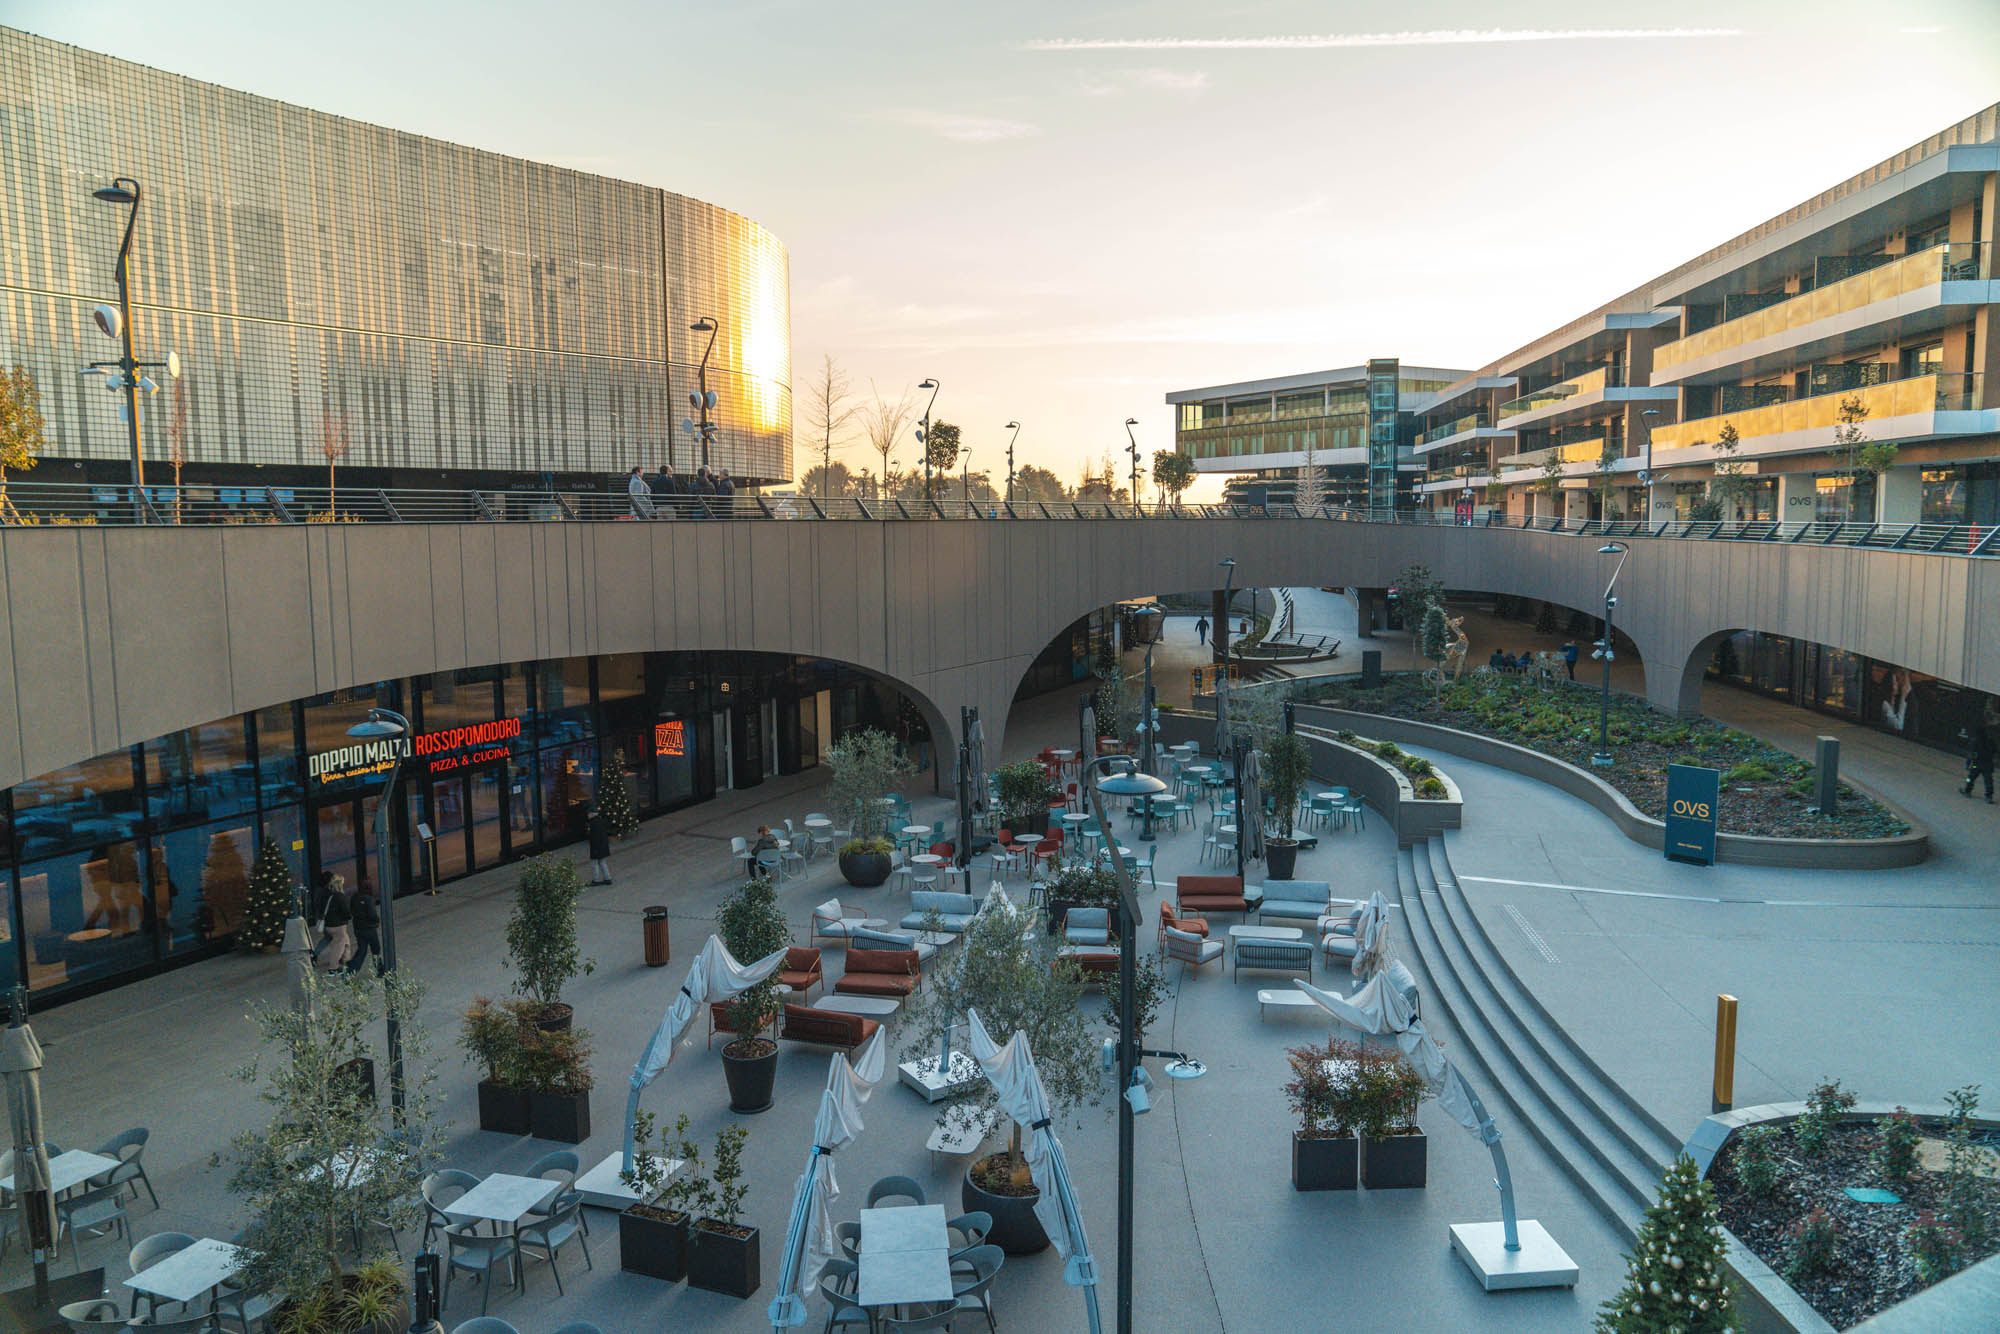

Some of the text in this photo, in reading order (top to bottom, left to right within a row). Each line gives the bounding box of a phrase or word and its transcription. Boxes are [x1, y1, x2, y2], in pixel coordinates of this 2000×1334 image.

[1655, 501, 1673, 509] OVS
[1789, 496, 1812, 506] OVS
[416, 717, 520, 756] ROSSOPOMODORO
[656, 729, 684, 749] IZZA
[309, 738, 412, 777] DOPPIO MALTO
[430, 747, 510, 773] PIZZA & CUCINA
[1673, 799, 1710, 818] OVS
